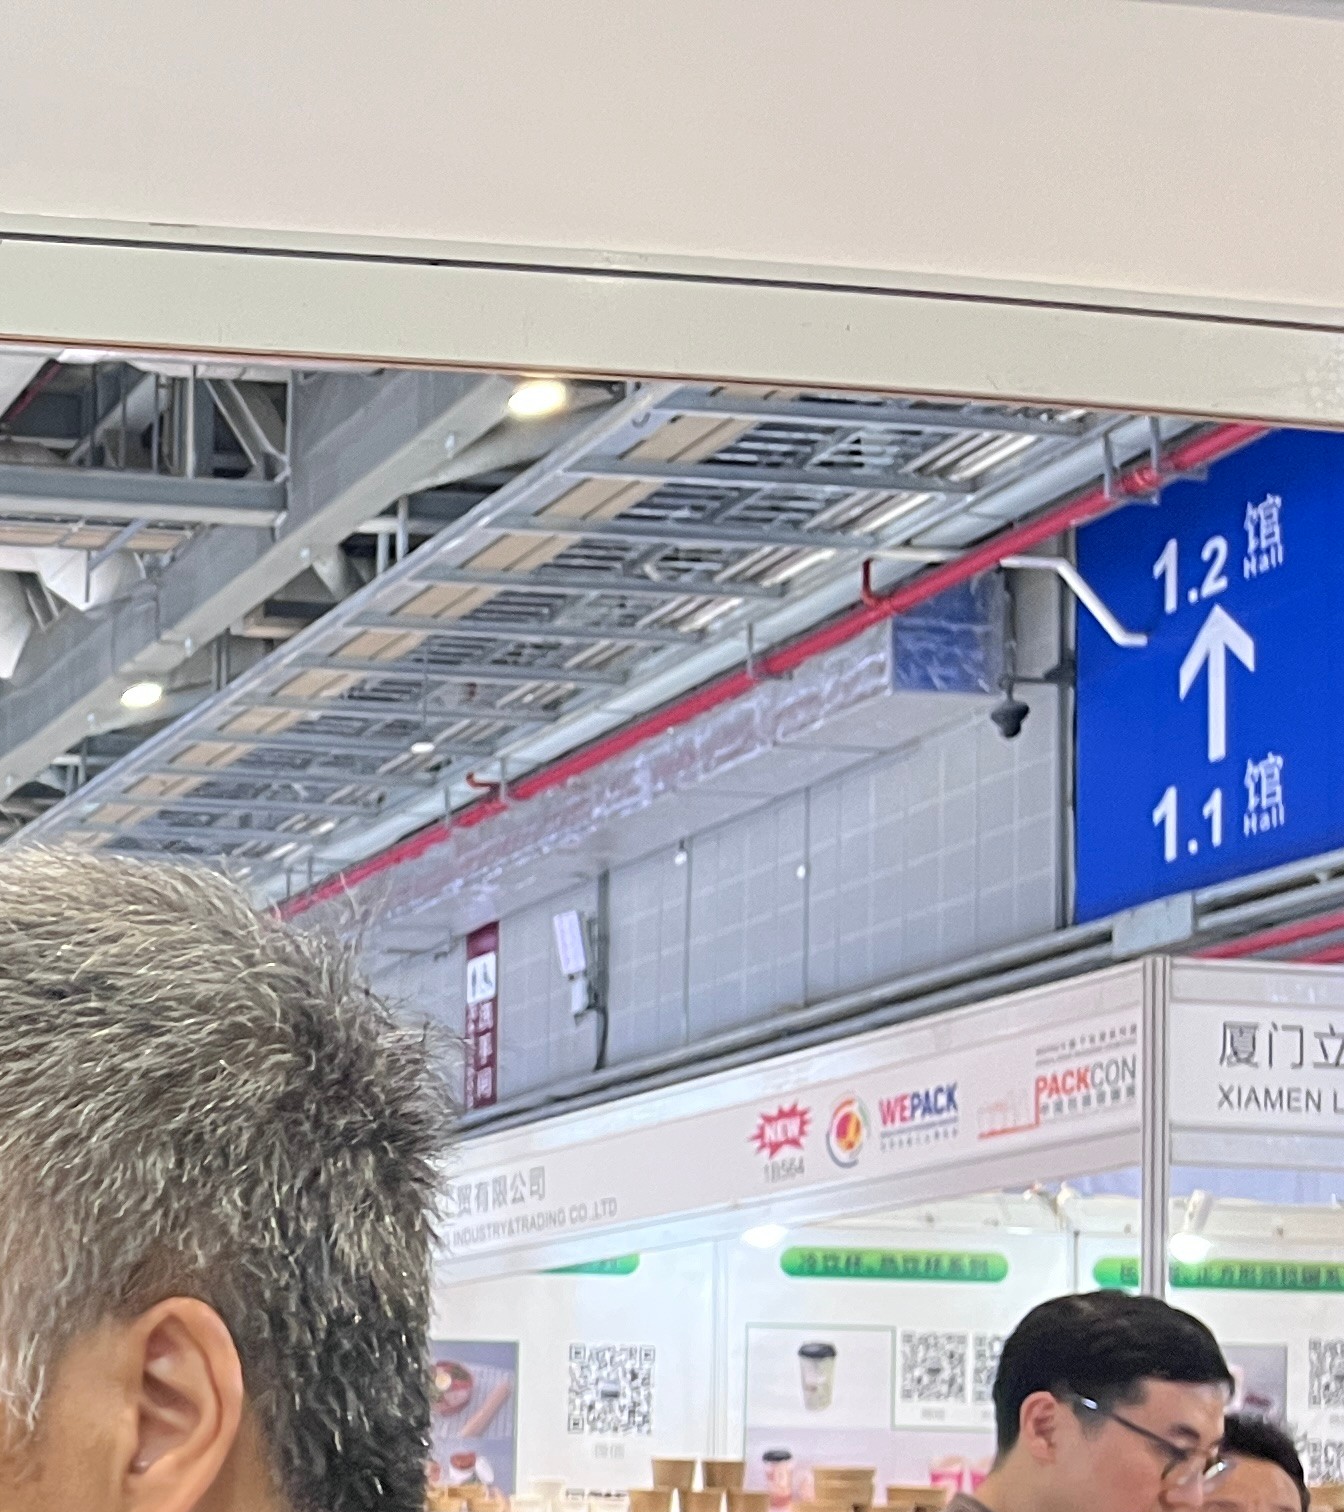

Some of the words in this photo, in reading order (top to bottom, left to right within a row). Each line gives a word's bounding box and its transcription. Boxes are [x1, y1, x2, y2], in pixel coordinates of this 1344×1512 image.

[1152, 535, 1228, 614] 1.2
[1243, 493, 1283, 554] 馆
[1243, 544, 1284, 580] Hall
[1152, 786, 1223, 863] 1.1
[1244, 752, 1284, 812] 馆
[1243, 803, 1285, 838] Hall
[1035, 1054, 1136, 1098] PACKCON
[1218, 1084, 1321, 1112] XIAMEN
[879, 1082, 958, 1126] WEPACK
[453, 1166, 546, 1217] 贸有限公司
